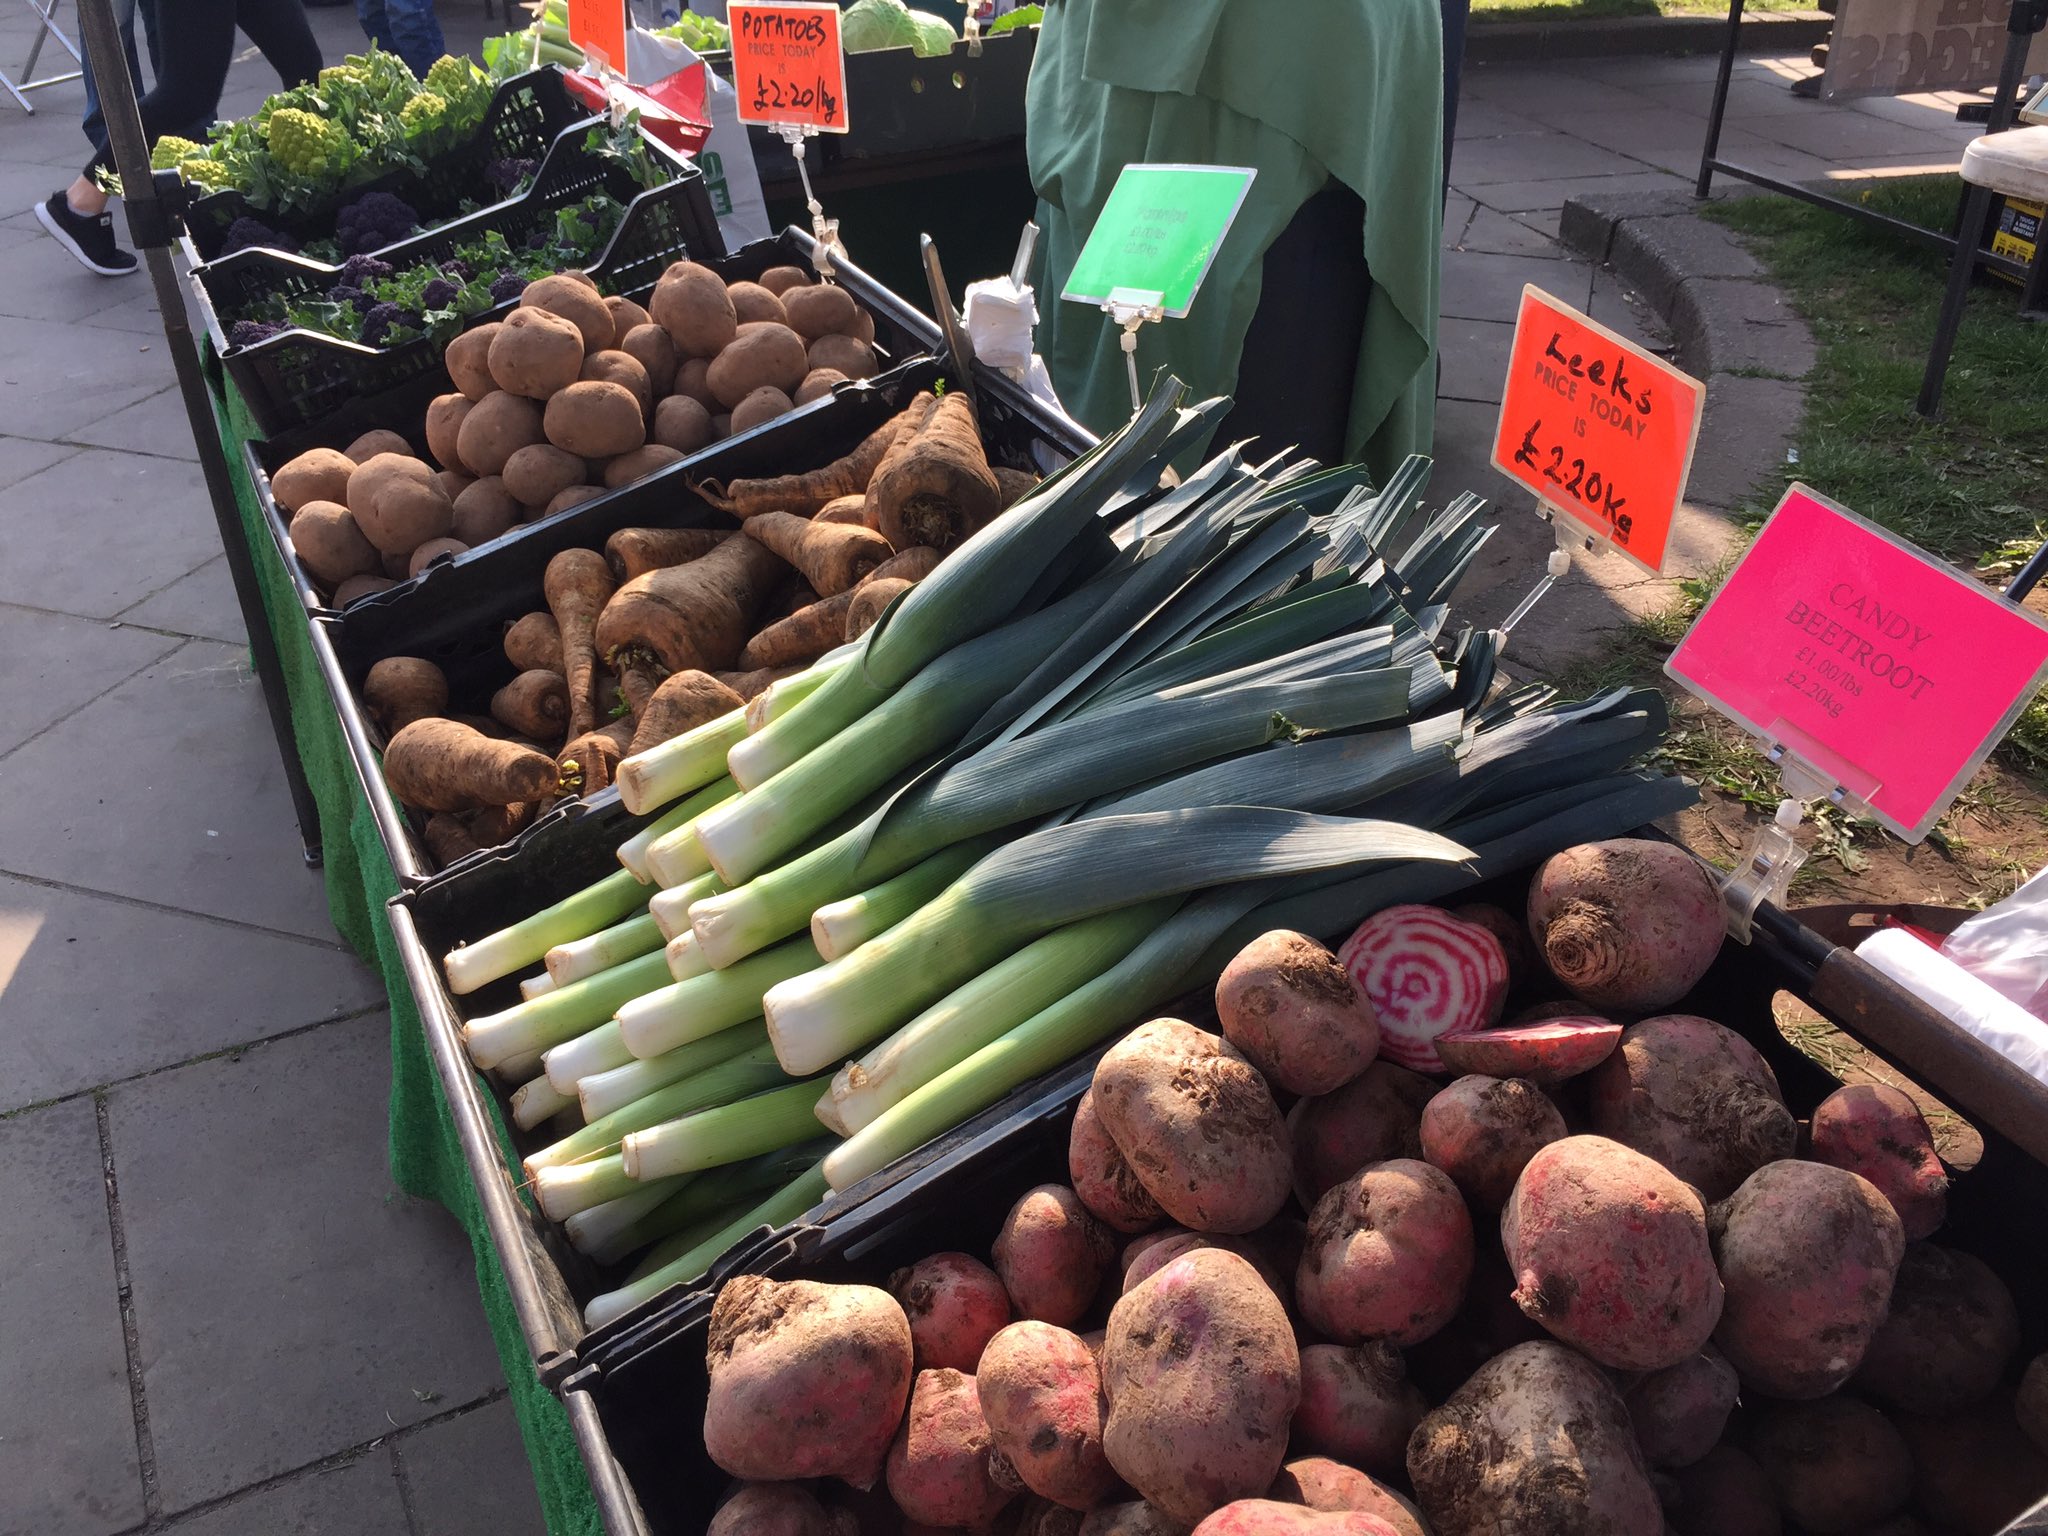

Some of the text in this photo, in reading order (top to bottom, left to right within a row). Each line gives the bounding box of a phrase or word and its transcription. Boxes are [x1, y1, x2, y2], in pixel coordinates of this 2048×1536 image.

[742, 11, 826, 47] POTATOES
[748, 43, 817, 58] PRICE TODAY
[778, 62, 786, 74] IS
[1545, 332, 1652, 415] Leeks
[1534, 361, 1647, 441] PRICE TODAY
[1573, 416, 1588, 438] IS
[1829, 583, 1933, 652] CANDY
[1785, 600, 1935, 700] BEETROOT
[1795, 646, 1863, 697] £1.00/lbs
[1784, 670, 1844, 719] £2.20kg
